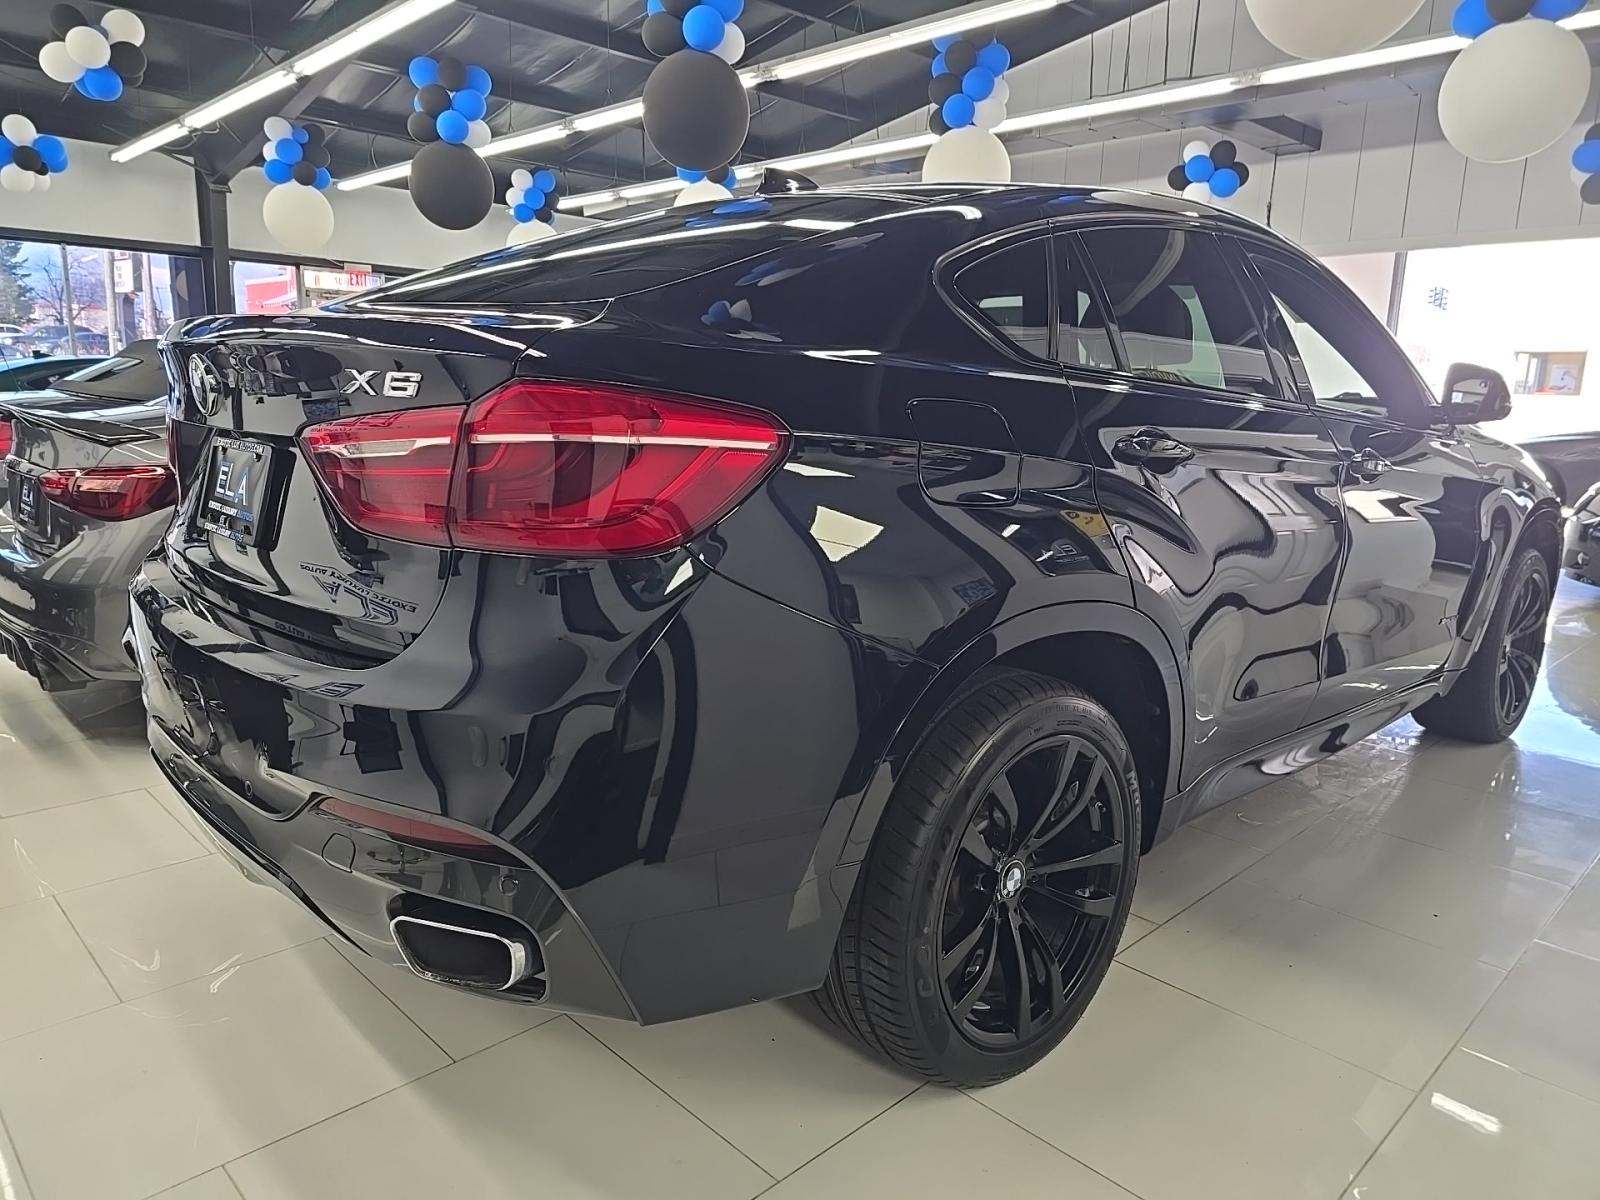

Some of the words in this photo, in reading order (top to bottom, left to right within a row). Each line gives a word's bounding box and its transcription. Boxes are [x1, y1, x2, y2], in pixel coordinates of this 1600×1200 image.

[349, 272, 367, 287] EXIT
[340, 368, 422, 399] X6
[215, 461, 249, 506] ELA
[299, 563, 329, 576] AUTOS
[330, 570, 371, 596] LUXURY
[372, 593, 418, 613] EXOTIC
